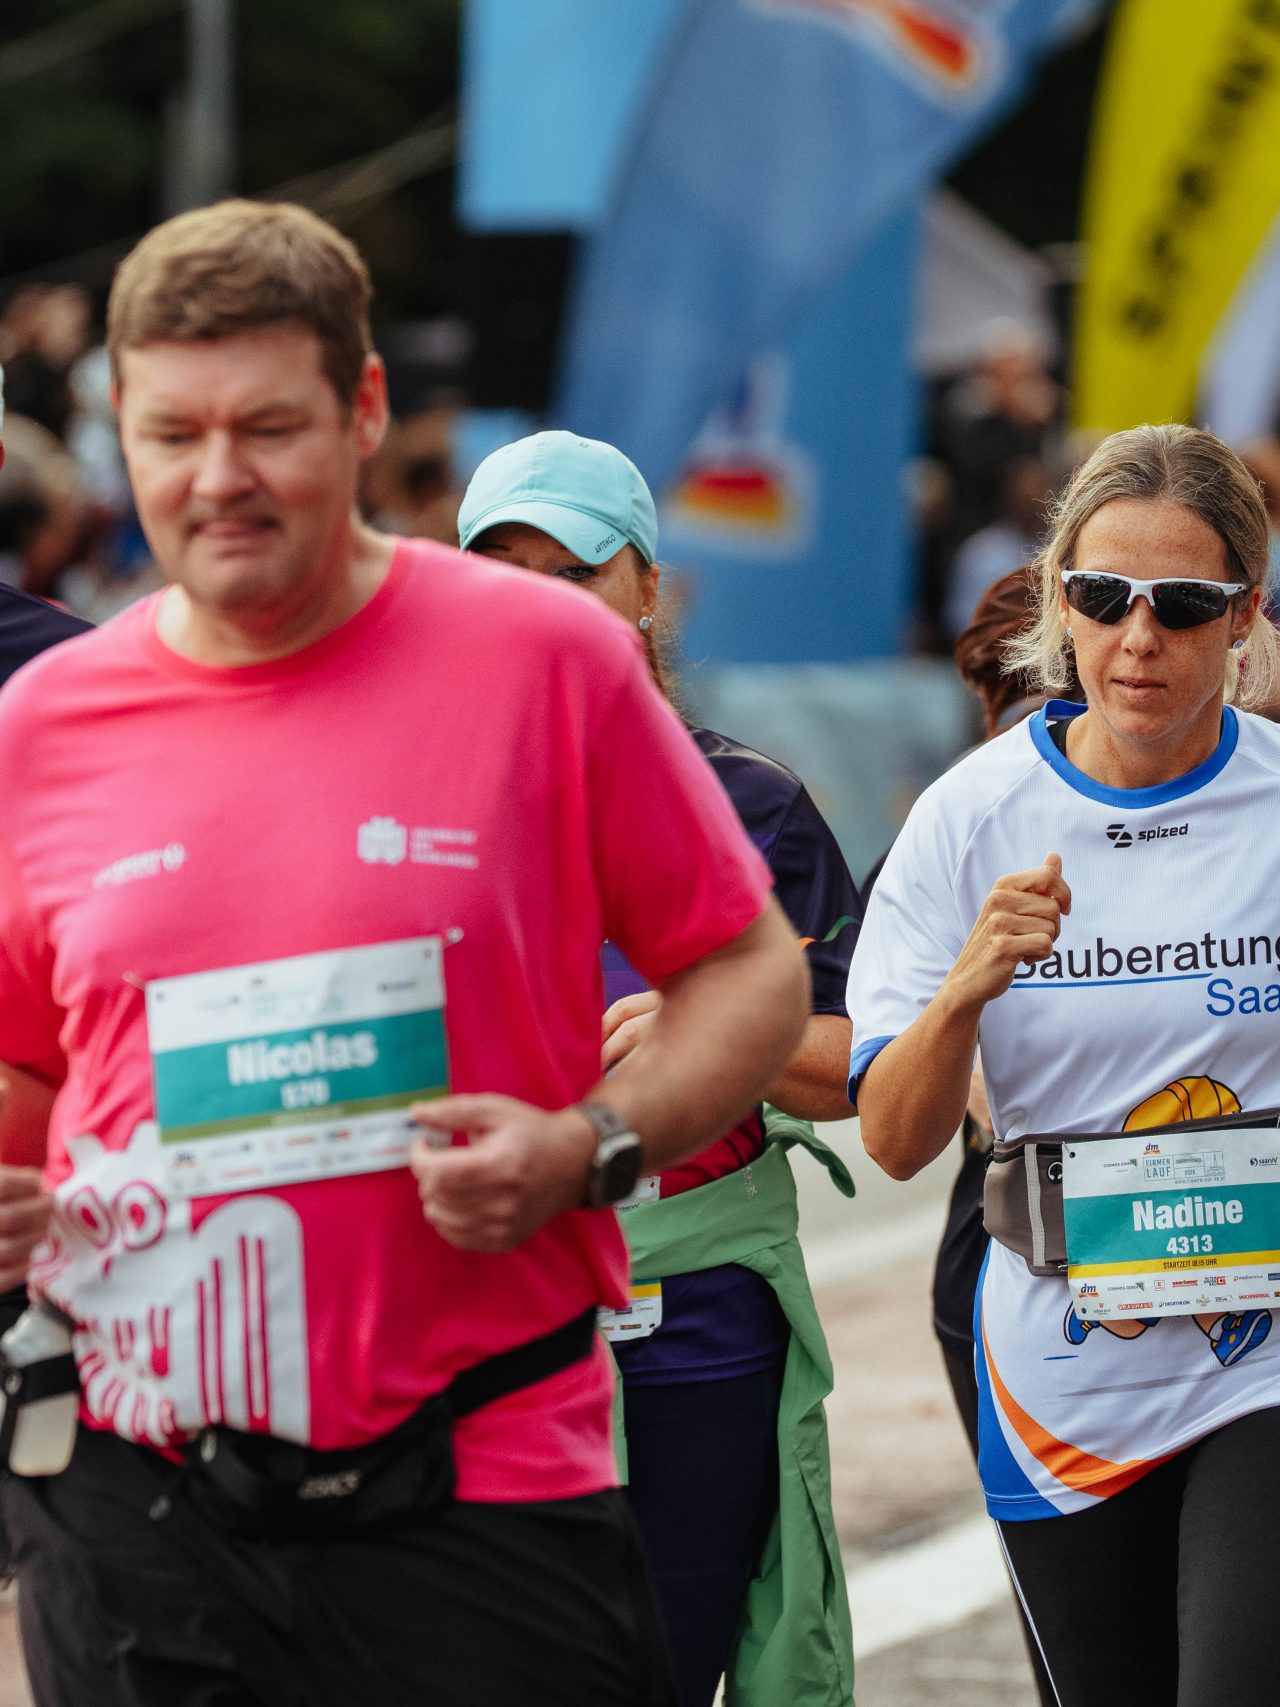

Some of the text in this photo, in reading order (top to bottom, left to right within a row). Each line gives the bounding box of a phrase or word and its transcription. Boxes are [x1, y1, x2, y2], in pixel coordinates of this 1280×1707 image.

[595, 533, 616, 554] ARTENGO
[1138, 823, 1189, 842] spized
[226, 1030, 379, 1086] Nicolas
[1145, 1158, 1171, 1167] FIRMEN
[1146, 1167, 1172, 1178] LAUF
[1132, 1195, 1244, 1231] Nadine
[1166, 1234, 1213, 1255] 4313
[1163, 1260, 1191, 1269] STARTZEIT
[1205, 1258, 1218, 1266] UHR
